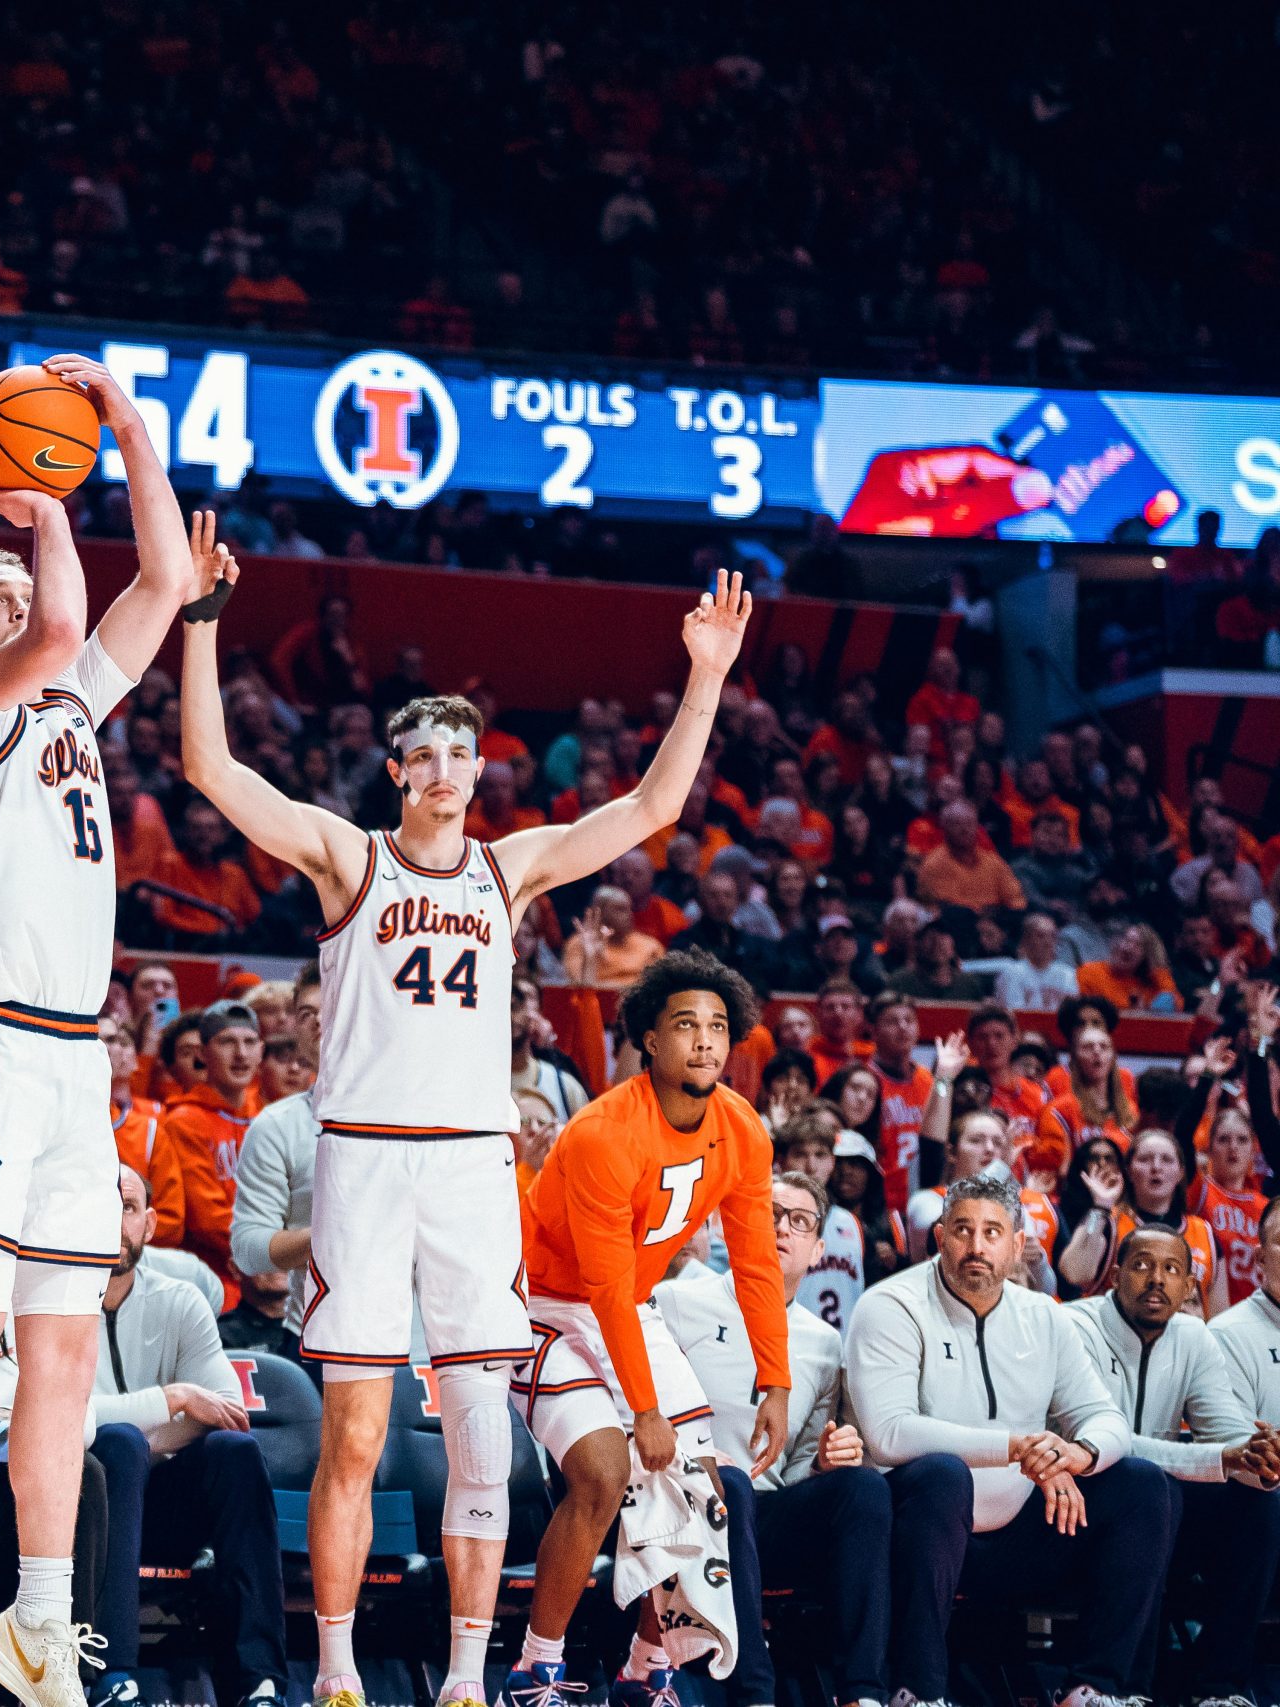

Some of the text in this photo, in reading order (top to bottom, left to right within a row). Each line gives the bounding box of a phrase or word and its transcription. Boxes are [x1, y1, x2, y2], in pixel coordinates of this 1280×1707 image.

[100, 342, 254, 490] 54
[356, 386, 422, 476] I
[491, 378, 636, 426] FOULS
[668, 387, 798, 437] T.O.L.
[539, 425, 594, 507] 2
[709, 437, 762, 519] 3
[62, 787, 104, 864] 15
[376, 896, 492, 947] Illinois
[392, 945, 479, 1010] 44
[642, 1155, 705, 1246] I
[944, 1342, 957, 1360] I
